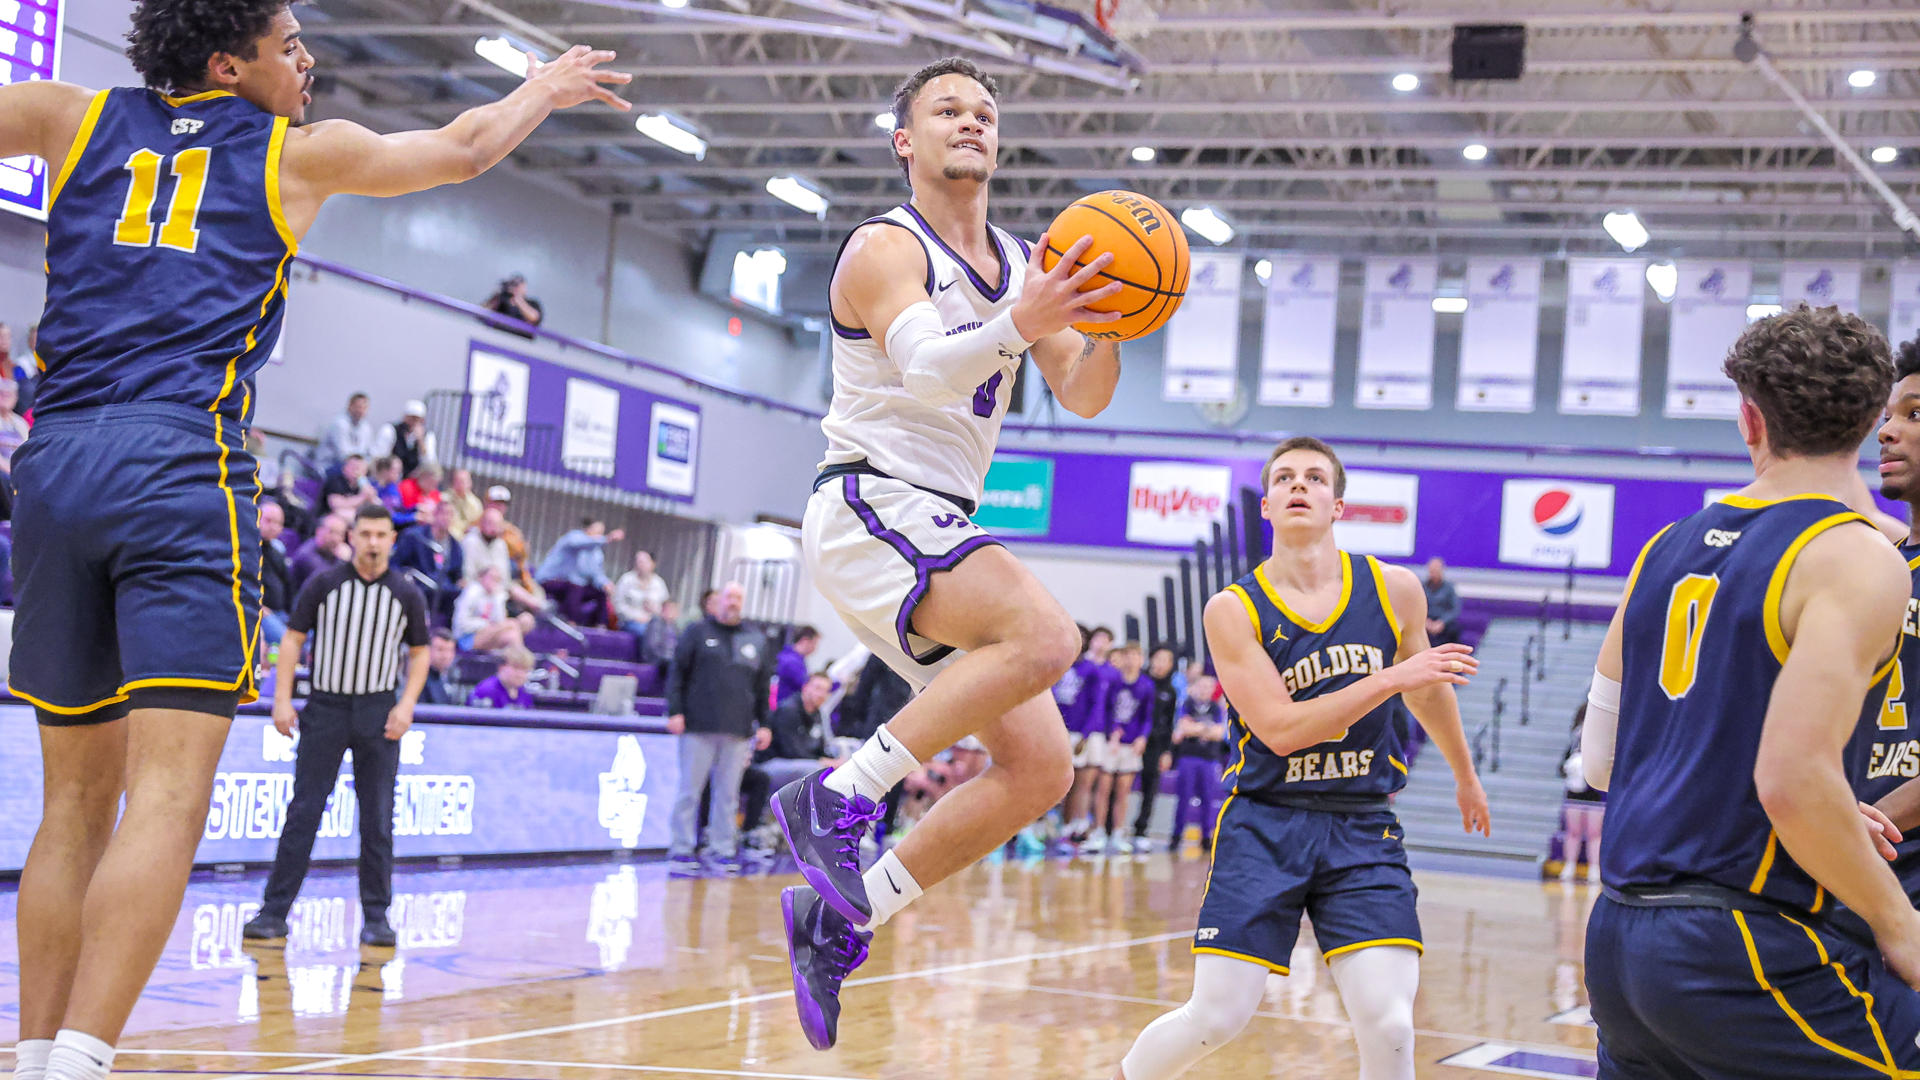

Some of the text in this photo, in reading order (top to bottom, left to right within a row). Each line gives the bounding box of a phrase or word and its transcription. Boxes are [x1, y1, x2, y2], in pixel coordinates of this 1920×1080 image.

[170, 118, 205, 135] CSP
[113, 147, 212, 254] 11
[1658, 572, 1720, 701] 0
[1281, 643, 1385, 697] GOLDEN
[1284, 748, 1375, 784] BEARS
[1866, 739, 1920, 780] EARS
[391, 774, 475, 836] ENTER
